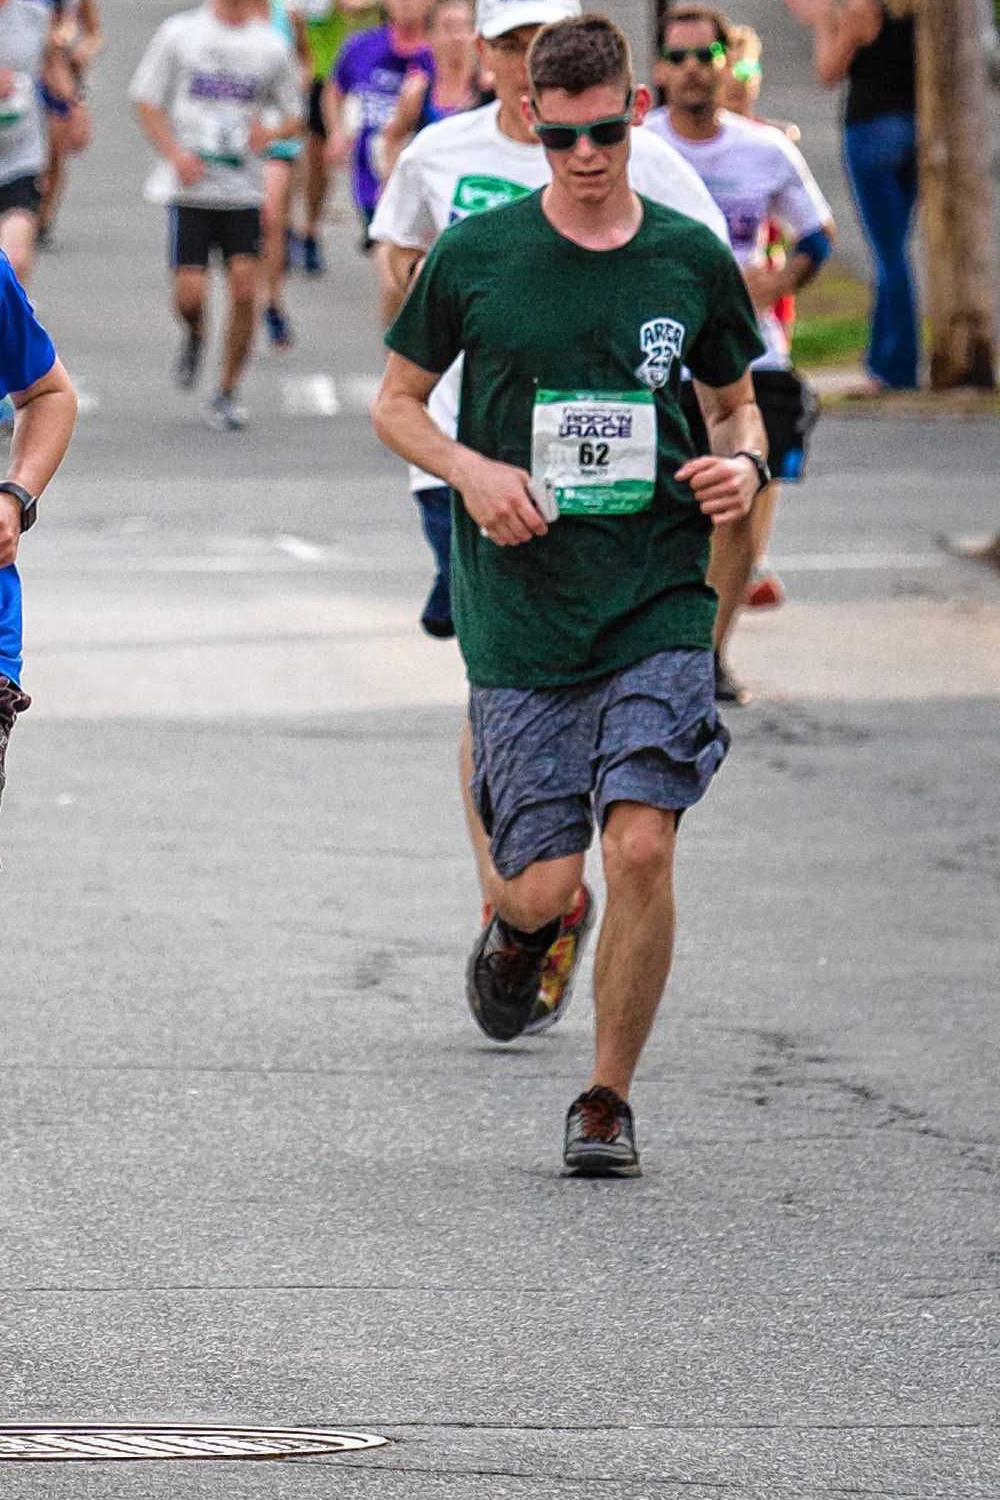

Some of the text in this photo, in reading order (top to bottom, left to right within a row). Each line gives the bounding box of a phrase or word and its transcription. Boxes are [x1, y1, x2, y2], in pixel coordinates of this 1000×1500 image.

[643, 322, 682, 352] AREA
[565, 425, 633, 438] RACE
[580, 441, 610, 467] 62
